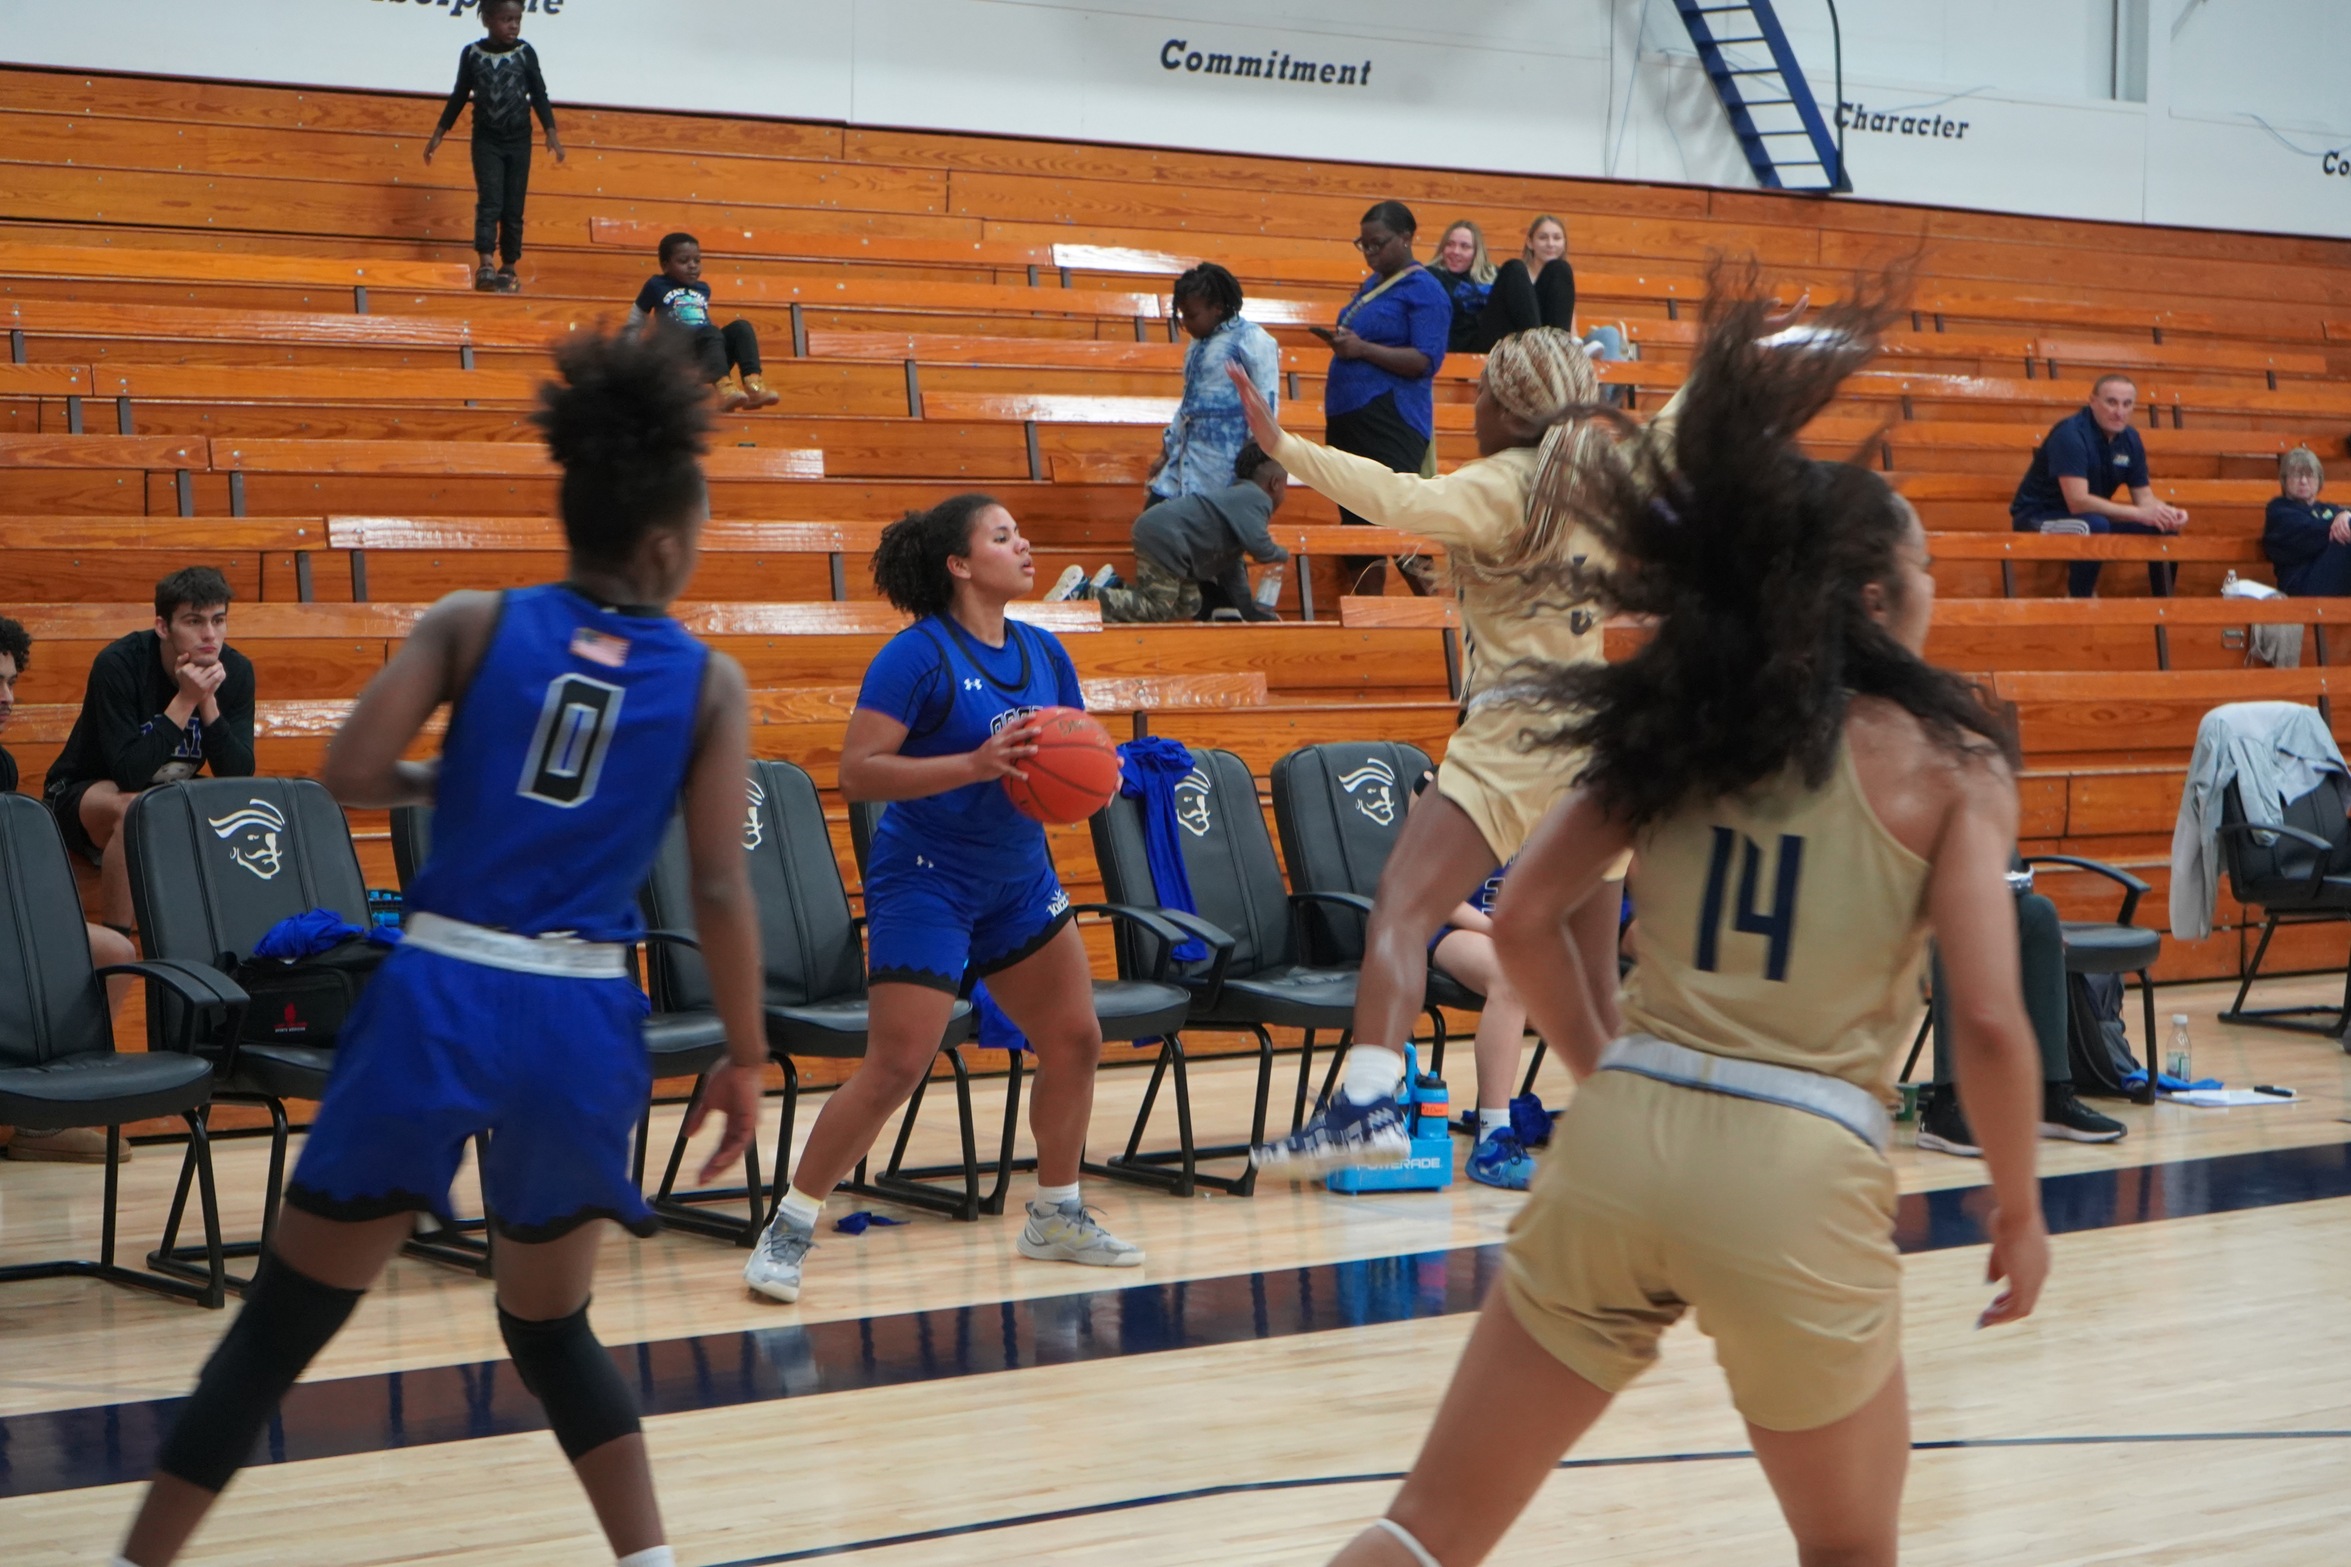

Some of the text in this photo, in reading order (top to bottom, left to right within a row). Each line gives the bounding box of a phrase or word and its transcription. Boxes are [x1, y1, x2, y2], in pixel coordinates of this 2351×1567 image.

[1160, 38, 1372, 86] Commitment
[1833, 101, 1969, 139] Character
[2322, 150, 2351, 176] Co
[516, 672, 626, 808] 0
[1693, 825, 1805, 983] 14
[1357, 1157, 1441, 1171] ERADE
